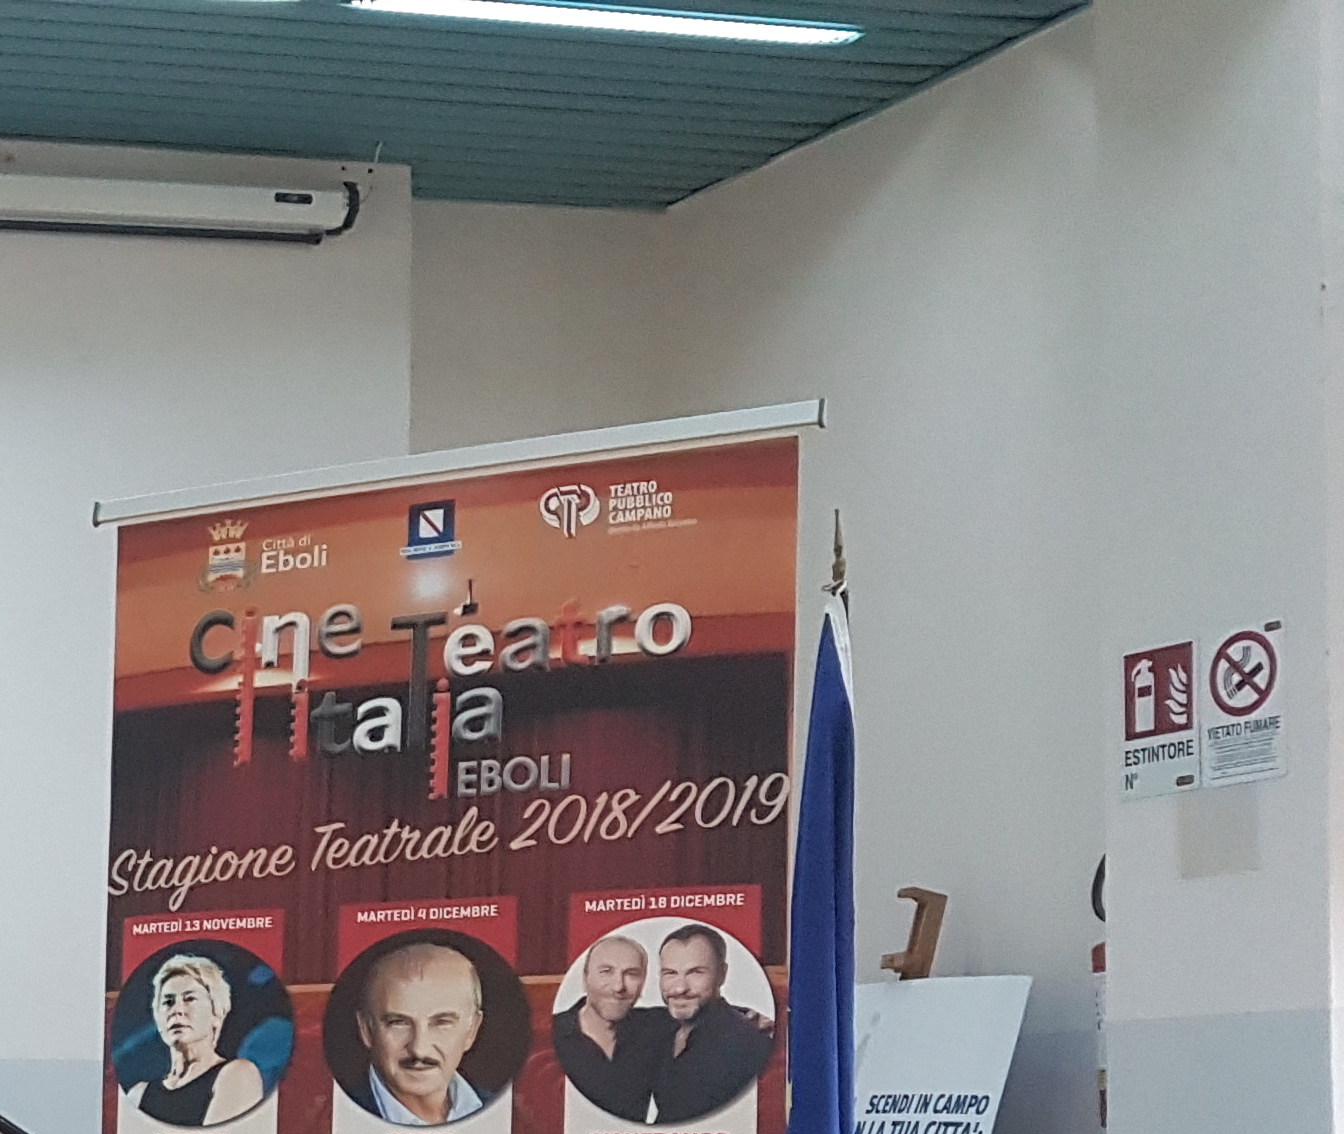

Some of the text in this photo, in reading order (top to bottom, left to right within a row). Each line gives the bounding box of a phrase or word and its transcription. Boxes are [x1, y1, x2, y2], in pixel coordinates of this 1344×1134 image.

[609, 481, 657, 497] TEATRO
[609, 492, 672, 510] PUBBLICO
[609, 506, 671, 524] CAMPANO
[299, 535, 311, 547] di
[262, 544, 328, 573] Eboli
[1208, 716, 1281, 740] VIETATO FUMARE
[1124, 739, 1194, 767] ESTINTORE
[457, 752, 572, 798] EBOLI
[108, 771, 790, 911] Stagione Teatrale 2018/2019
[649, 893, 745, 909] 18 DICEMBRE
[418, 905, 498, 919] 4 DICEMBRE
[185, 917, 273, 932] 13 NOVEMBRE
[865, 1094, 990, 1115] SCENDI IN CAMPO
